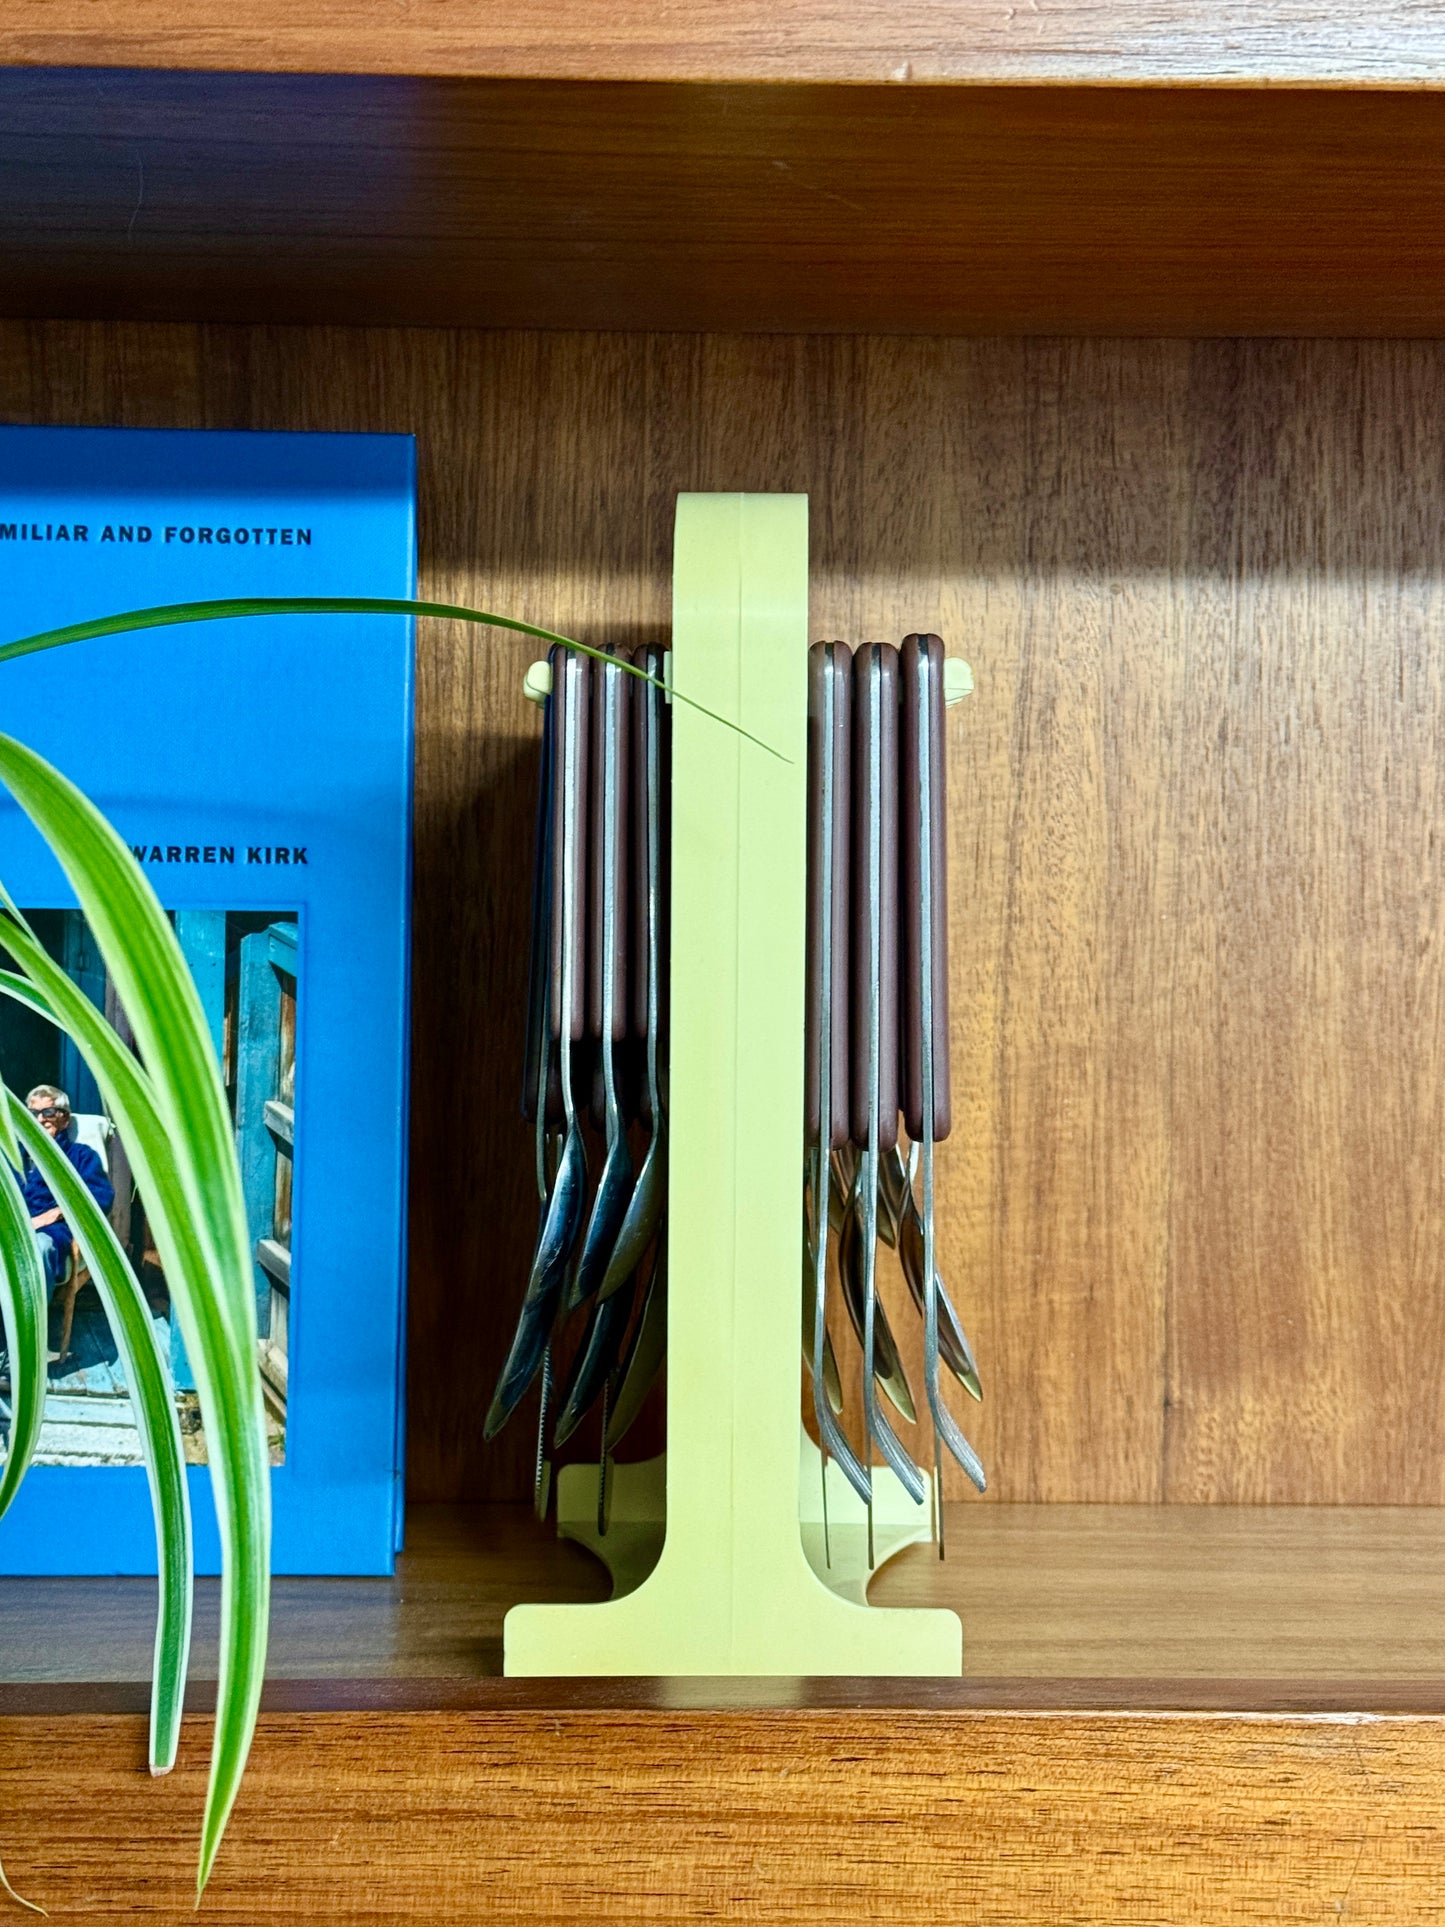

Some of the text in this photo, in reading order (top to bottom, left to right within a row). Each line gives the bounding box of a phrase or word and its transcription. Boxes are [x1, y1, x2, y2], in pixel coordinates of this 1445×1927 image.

[101, 525, 152, 543] AND
[164, 526, 312, 545] FORGOTTEN
[127, 845, 308, 865] WARREN KIRK
